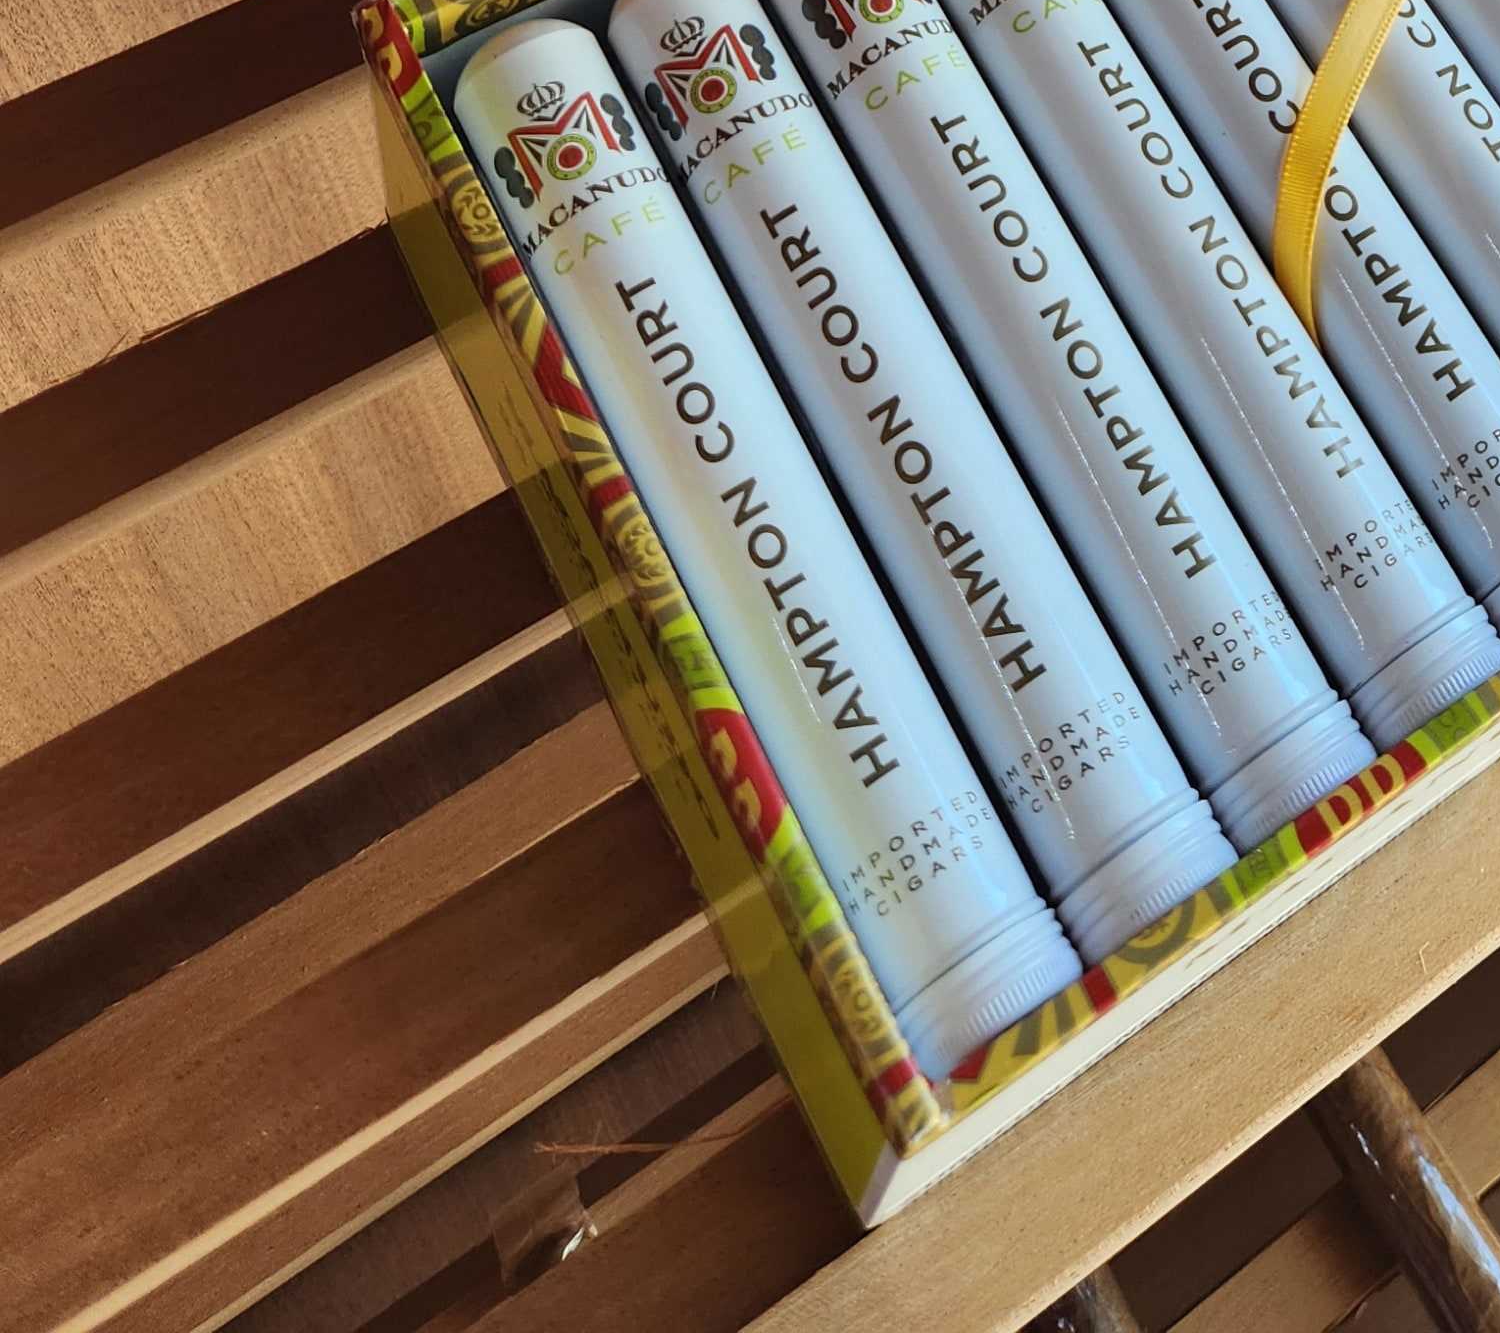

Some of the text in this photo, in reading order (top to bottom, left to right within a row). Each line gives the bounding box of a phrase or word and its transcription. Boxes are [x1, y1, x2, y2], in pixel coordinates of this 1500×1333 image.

[865, 44, 966, 111] CAFÉ
[703, 122, 807, 206] CAFÉ
[553, 195, 666, 277] CAFÉ
[1076, 39, 1365, 478] HAMPTON COURT
[1320, 165, 1476, 402] HAMPTO
[929, 114, 1218, 579] HAMPTON COURT
[760, 203, 1048, 693] HAMPTON COURT
[614, 276, 901, 789] HAMPTON COURT
[1199, 628, 1293, 695] CIGARS
[1001, 691, 1125, 789] IMPORTED
[1006, 705, 1141, 811] HANDMADE
[1029, 735, 1131, 814] CIGARS
[843, 790, 978, 892] IMPORTED
[847, 805, 992, 916] HANDMADE
[876, 834, 984, 918] CIGARS
